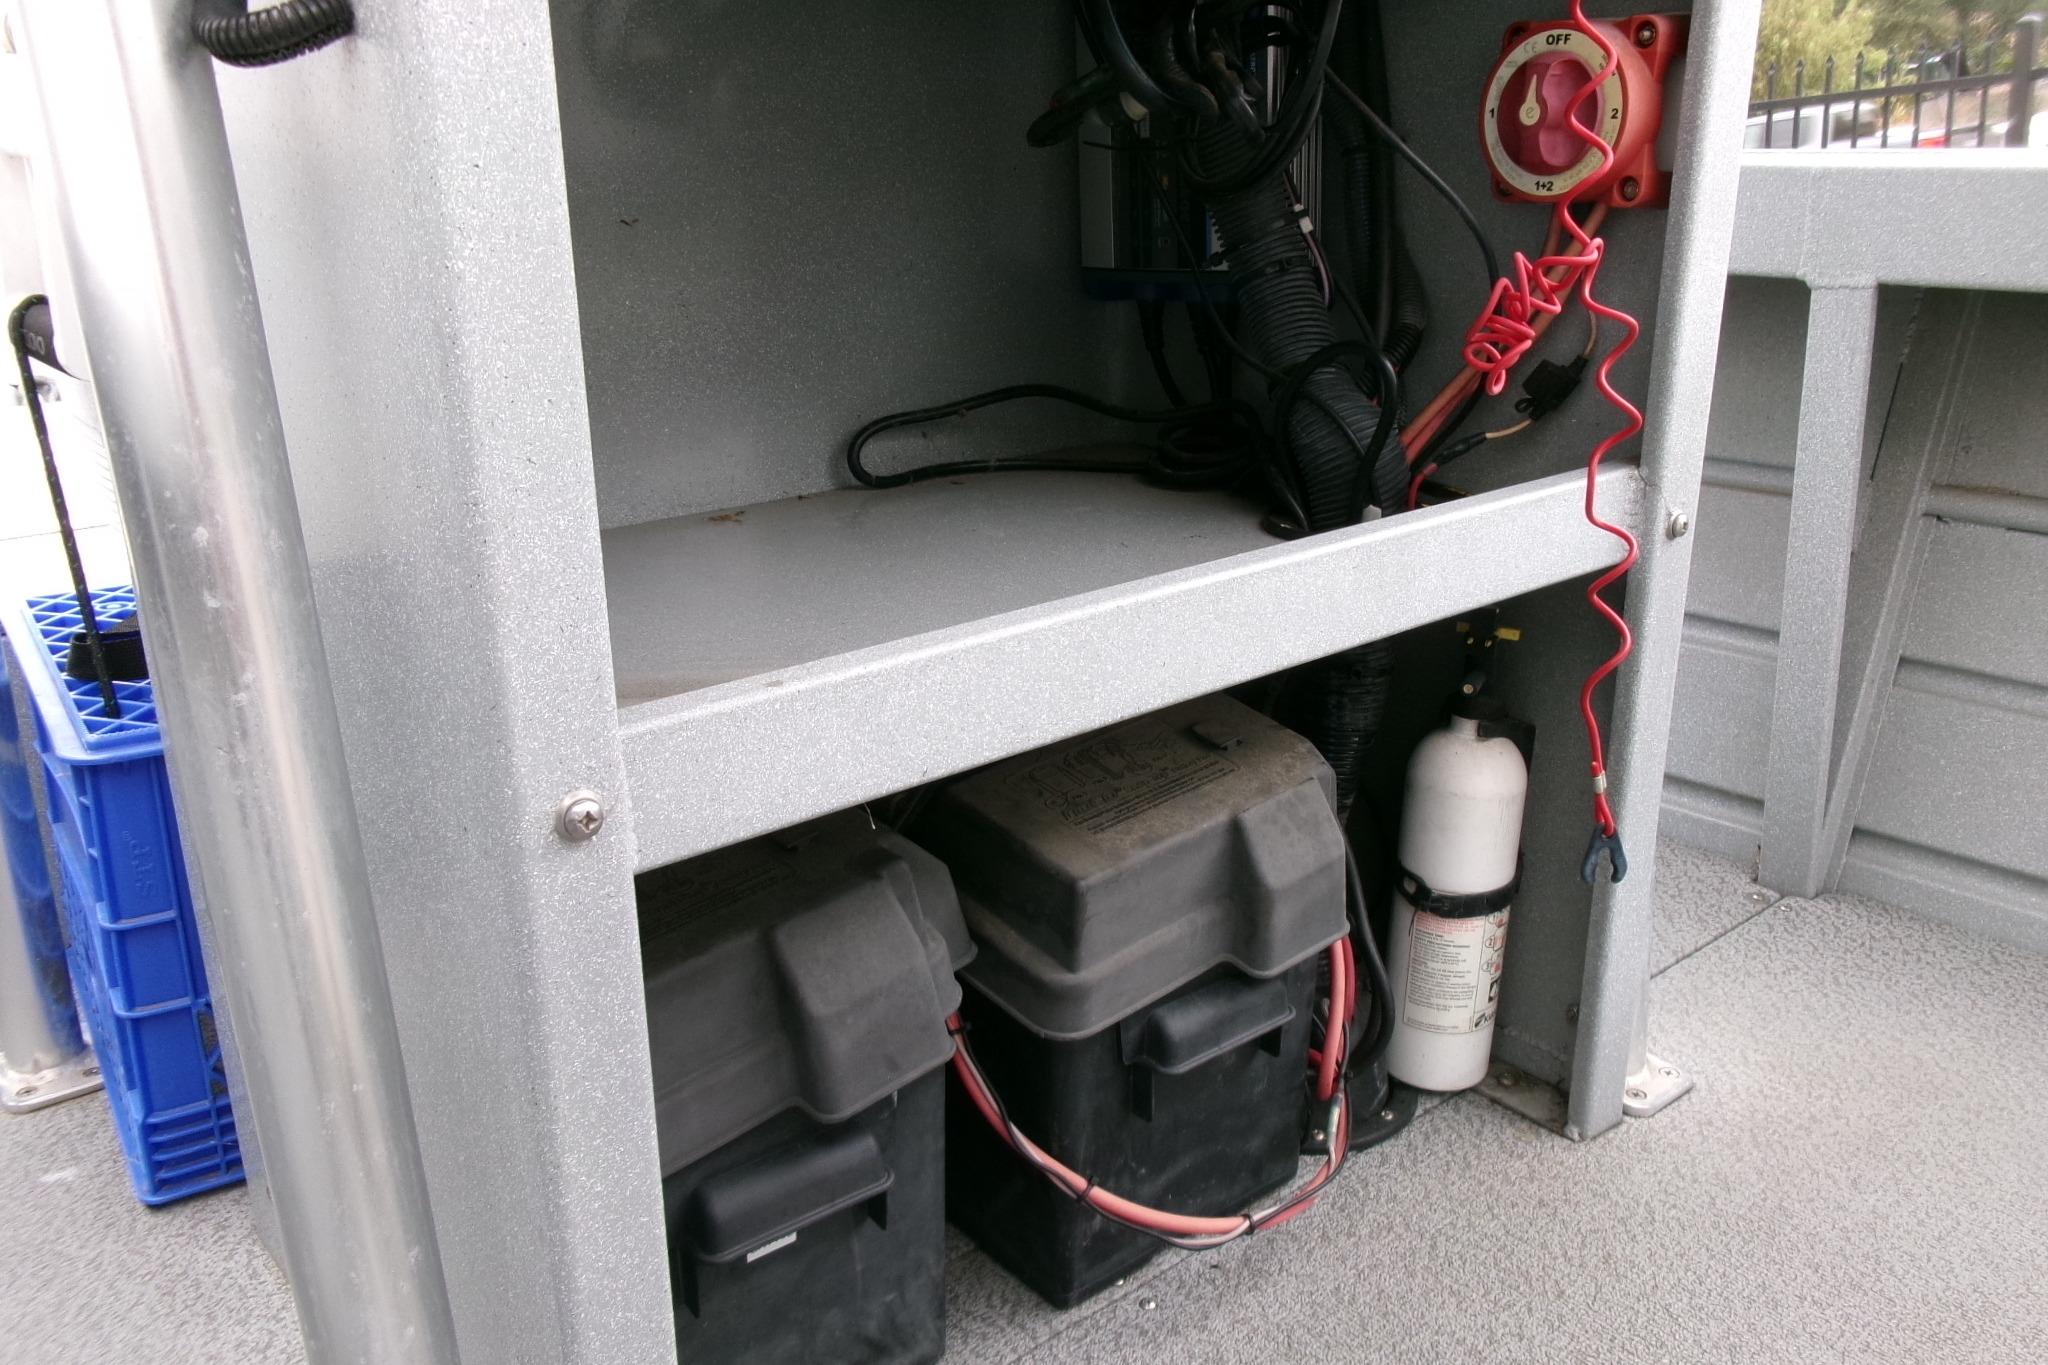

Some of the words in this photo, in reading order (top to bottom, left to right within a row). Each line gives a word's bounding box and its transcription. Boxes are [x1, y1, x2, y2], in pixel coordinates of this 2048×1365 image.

[1546, 33, 1571, 45] OFF
[1489, 108, 1495, 118] 1
[1610, 108, 1619, 119] 2
[1534, 180, 1554, 192] 1+2
